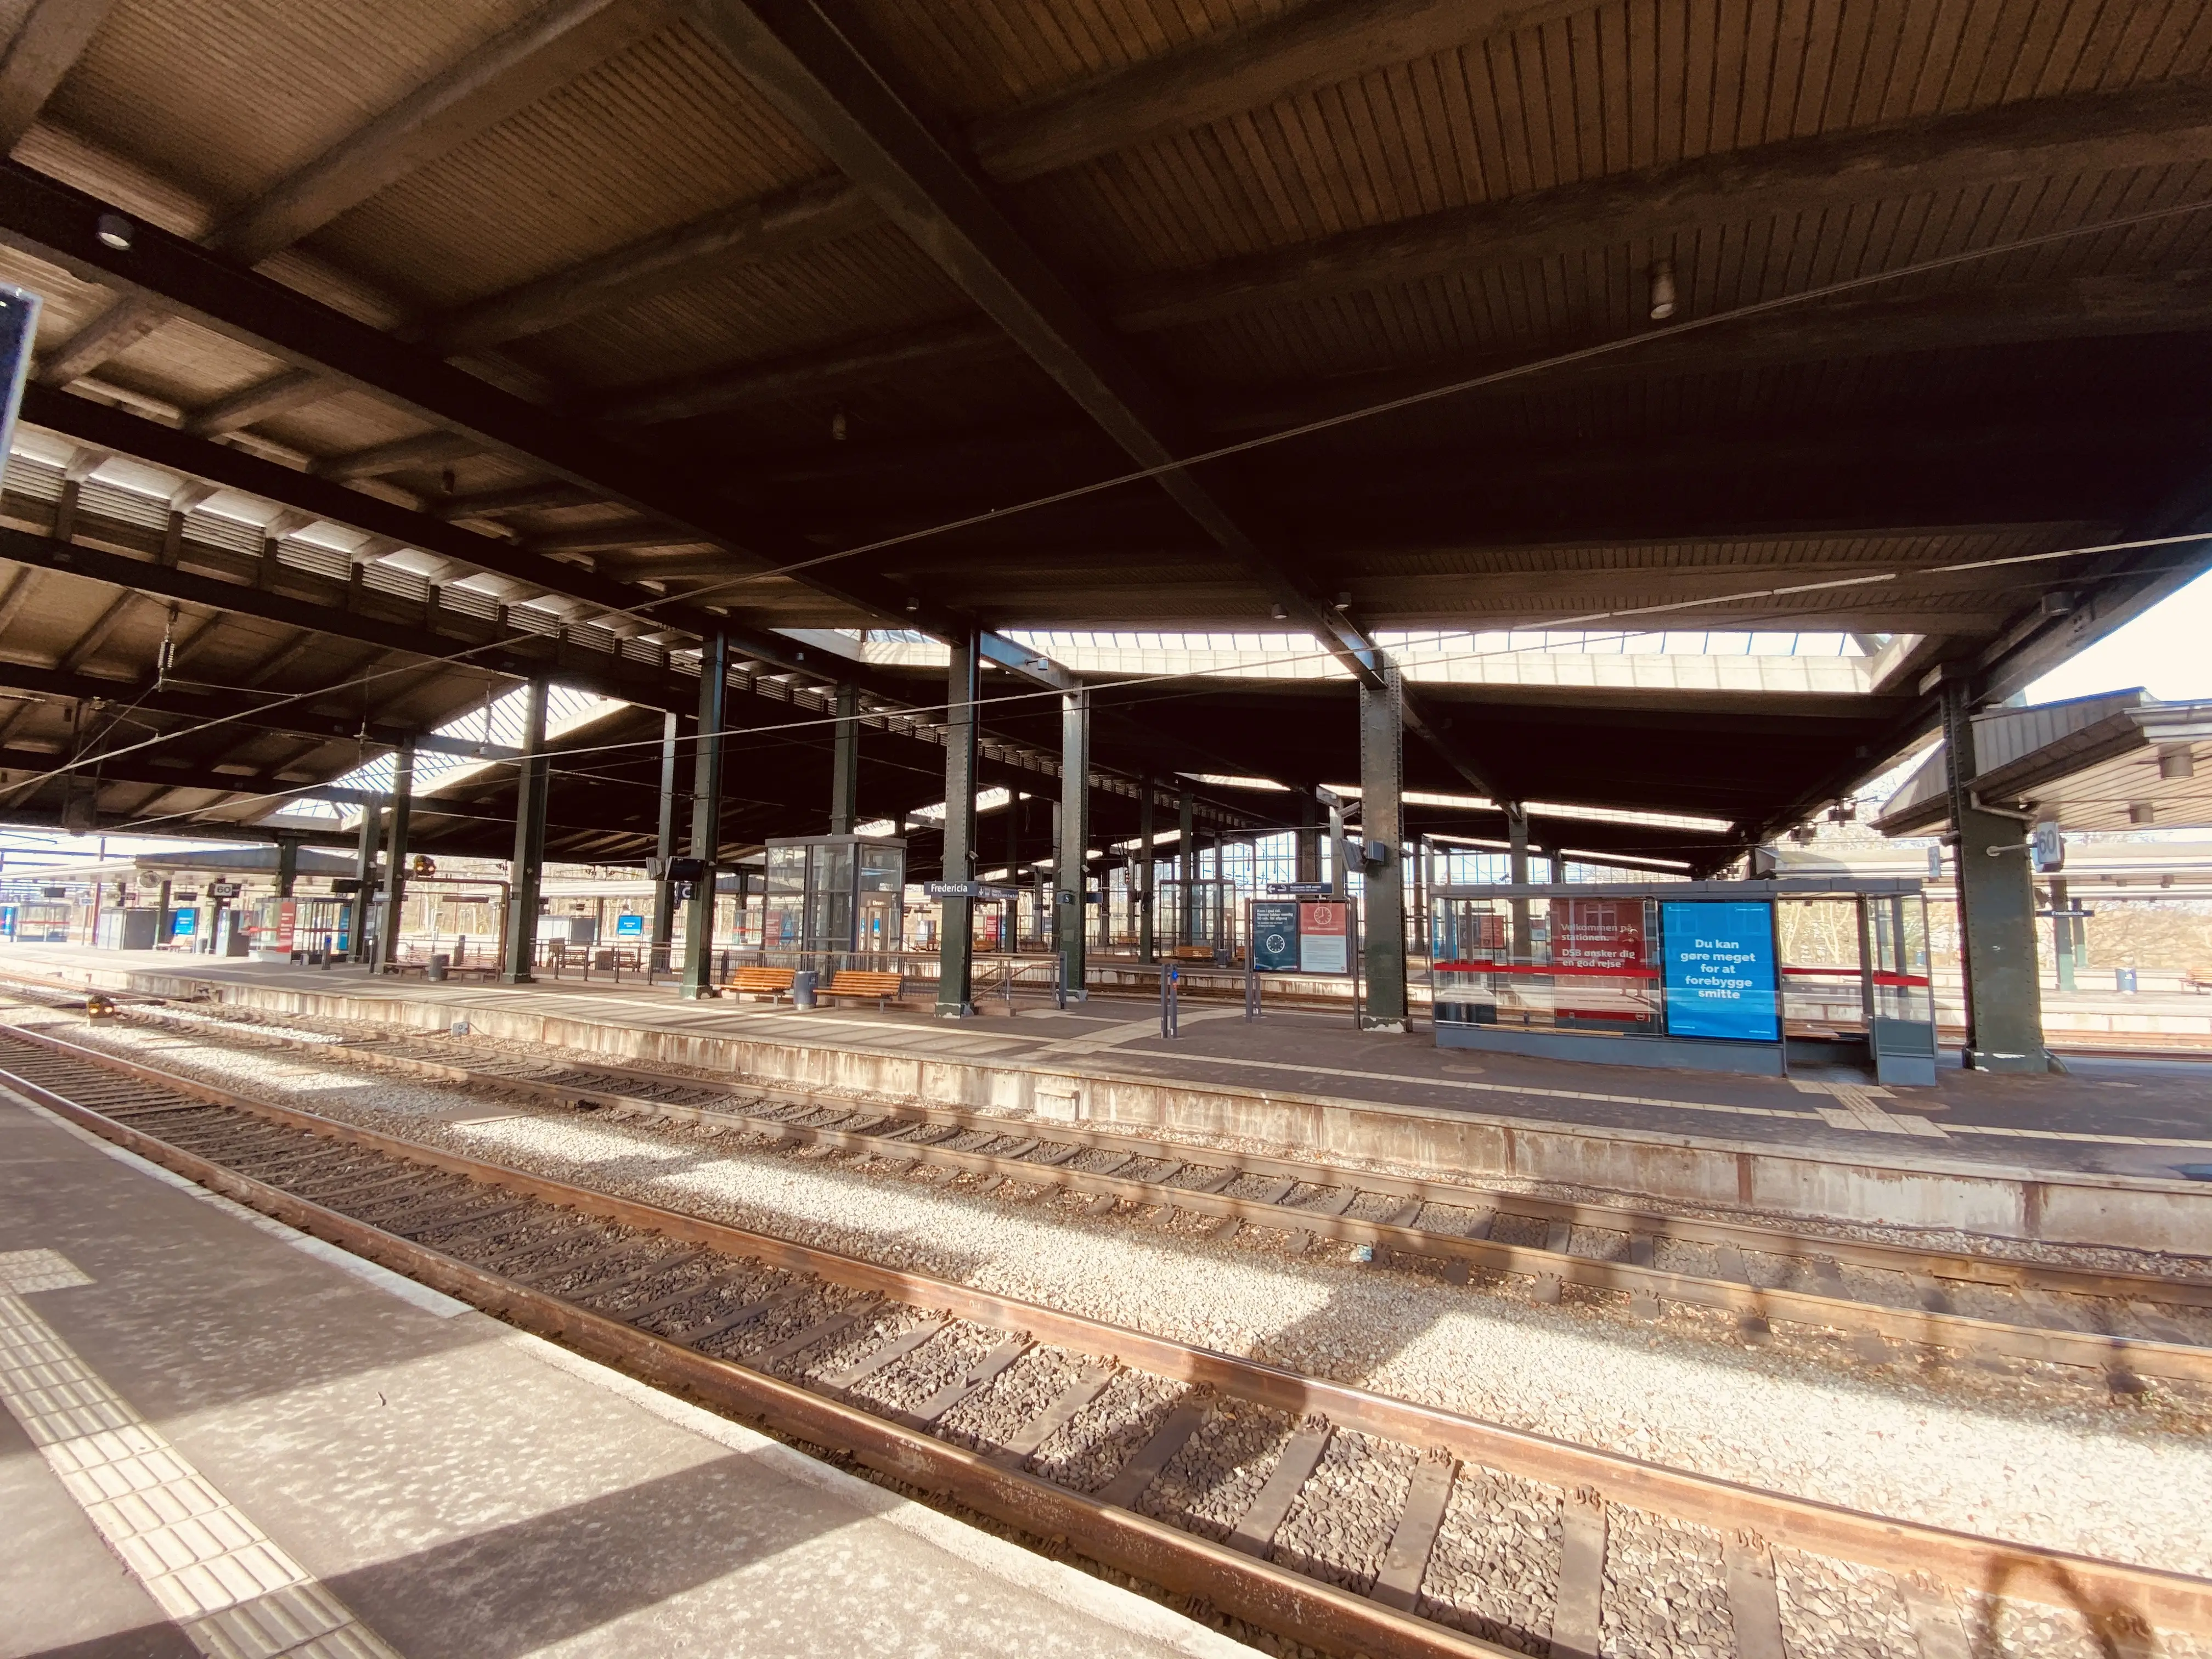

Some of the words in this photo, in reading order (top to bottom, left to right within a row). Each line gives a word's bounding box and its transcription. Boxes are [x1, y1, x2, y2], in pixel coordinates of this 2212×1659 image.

[2038, 829, 2056, 854] 60
[216, 885, 231, 894] 60
[930, 883, 968, 893] Fredericia
[1561, 923, 1618, 932] Velkommen
[1695, 939, 1713, 948] Du
[1716, 939, 1739, 949] kan
[1620, 950, 1635, 959] dig
[1680, 953, 1710, 962] gøre
[1713, 953, 1756, 963] meget
[1577, 960, 1595, 968] god
[1598, 960, 1622, 968] rejse
[1701, 963, 1719, 973] for
[1722, 965, 1736, 974] at
[1685, 975, 1753, 989] forebygge
[1698, 989, 1740, 999] smitte
